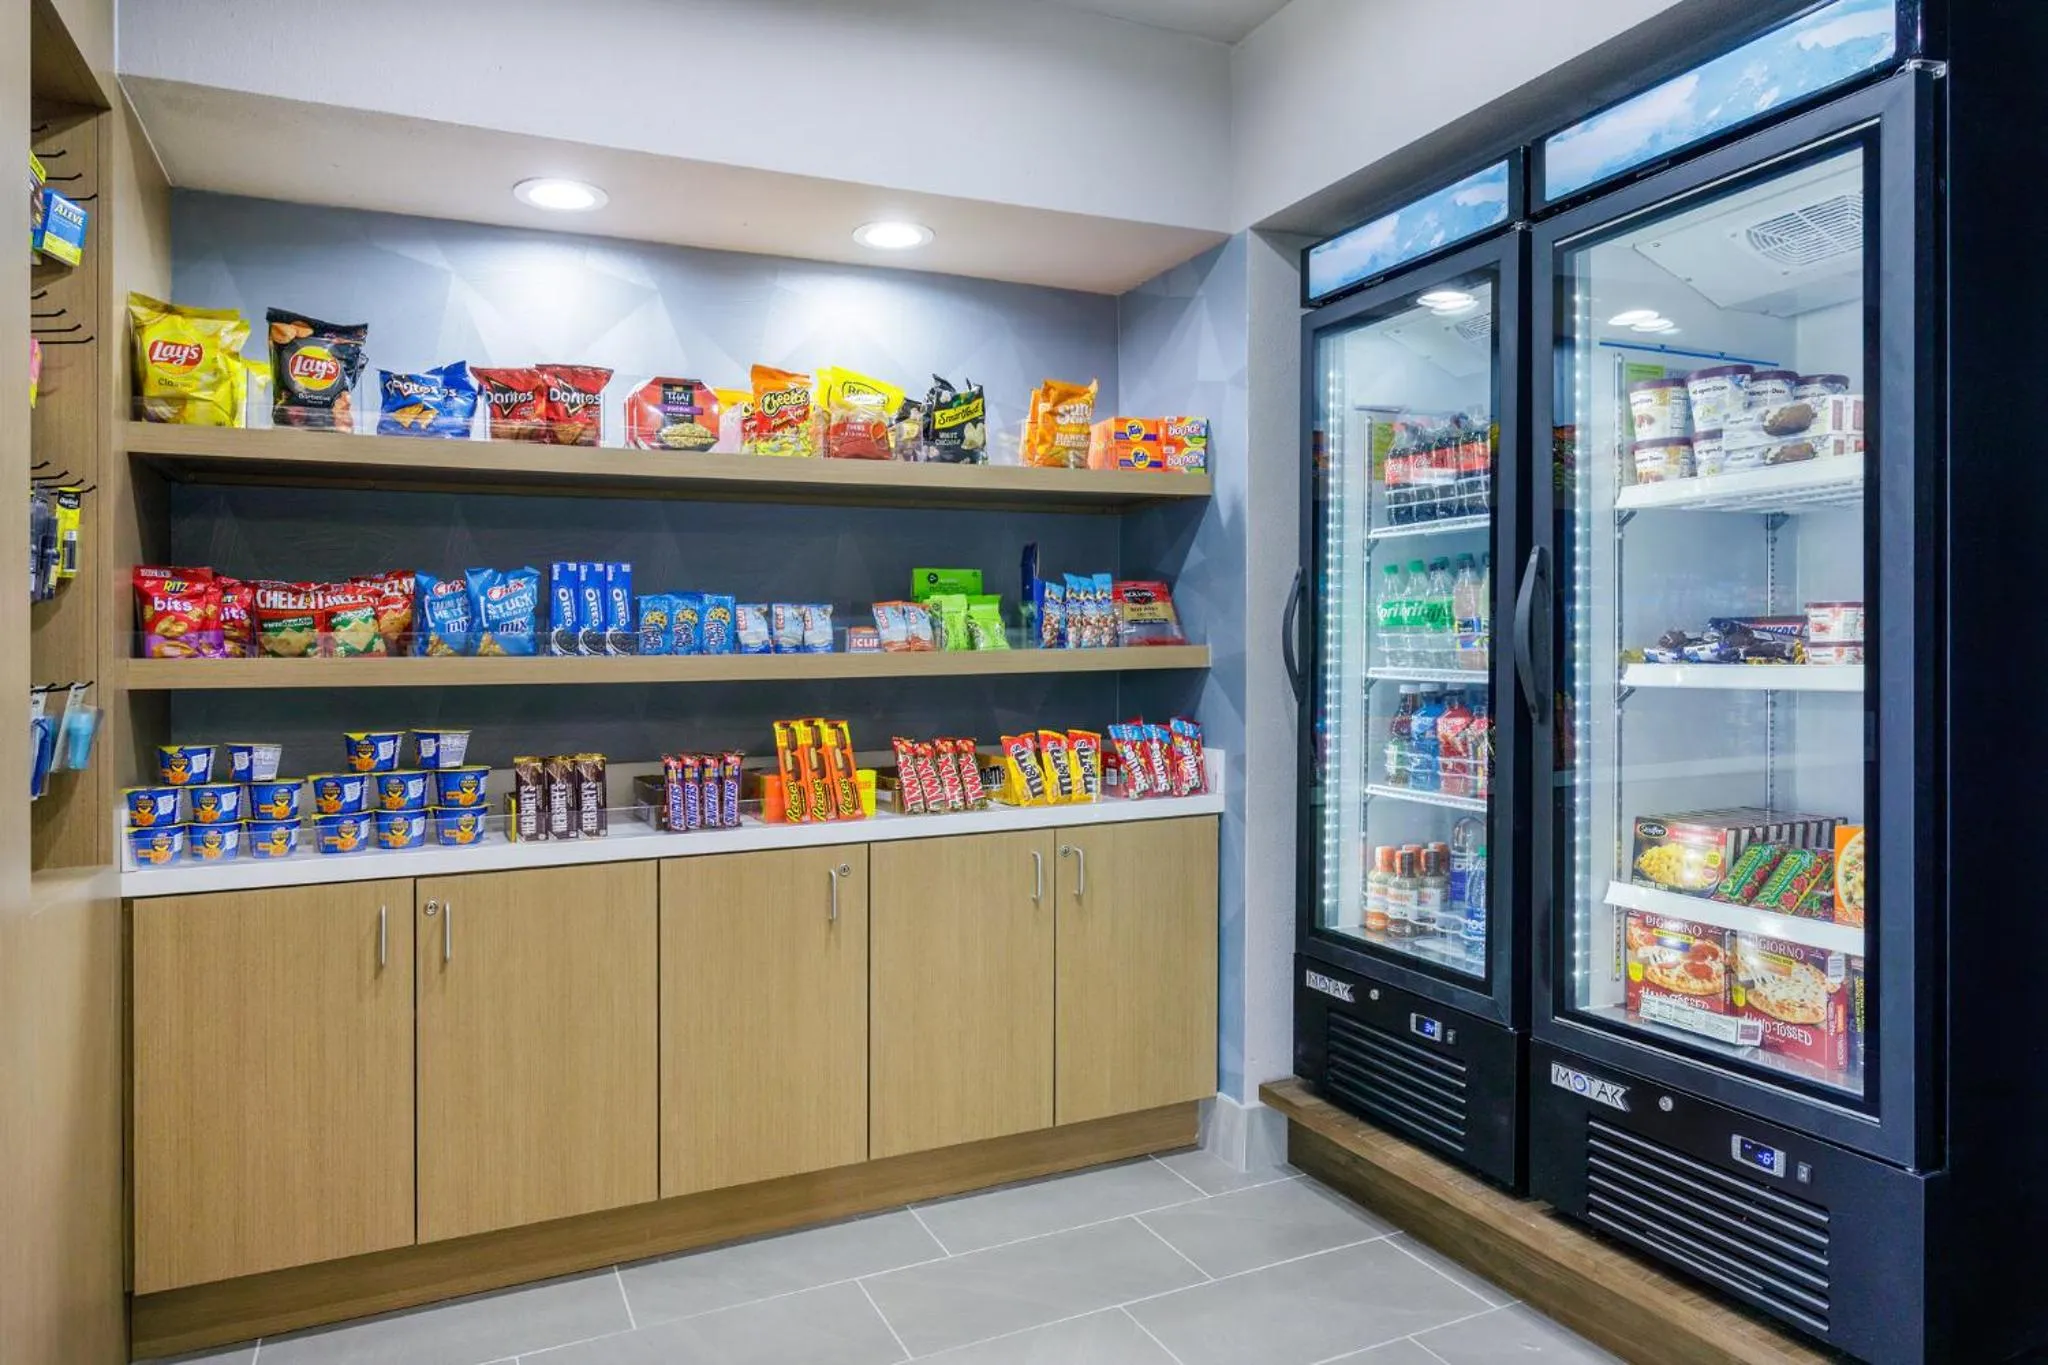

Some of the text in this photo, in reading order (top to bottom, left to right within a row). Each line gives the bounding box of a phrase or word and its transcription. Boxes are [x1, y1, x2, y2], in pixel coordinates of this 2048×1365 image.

[54, 202, 85, 227] ALEVE
[152, 340, 201, 366] Lay's
[293, 355, 338, 380] Lay's
[487, 390, 534, 404] Doritos
[549, 388, 602, 406] Doritos
[762, 388, 809, 416] Cheetos
[1127, 424, 1143, 435] Tide
[1133, 451, 1148, 463] Tide
[163, 580, 189, 592] RITZ
[153, 596, 193, 612] bits
[558, 588, 573, 627] OREO
[585, 588, 599, 627] OREO
[612, 588, 626, 627] OREO
[499, 617, 529, 634] mix
[669, 783, 686, 831] SNICKERS
[685, 783, 700, 830] SNICKERS
[704, 782, 720, 827] SNICKERS
[724, 780, 739, 827] SNICKERS
[1310, 973, 1351, 1000] MOTAK
[1555, 1066, 1622, 1107] MOTAK
